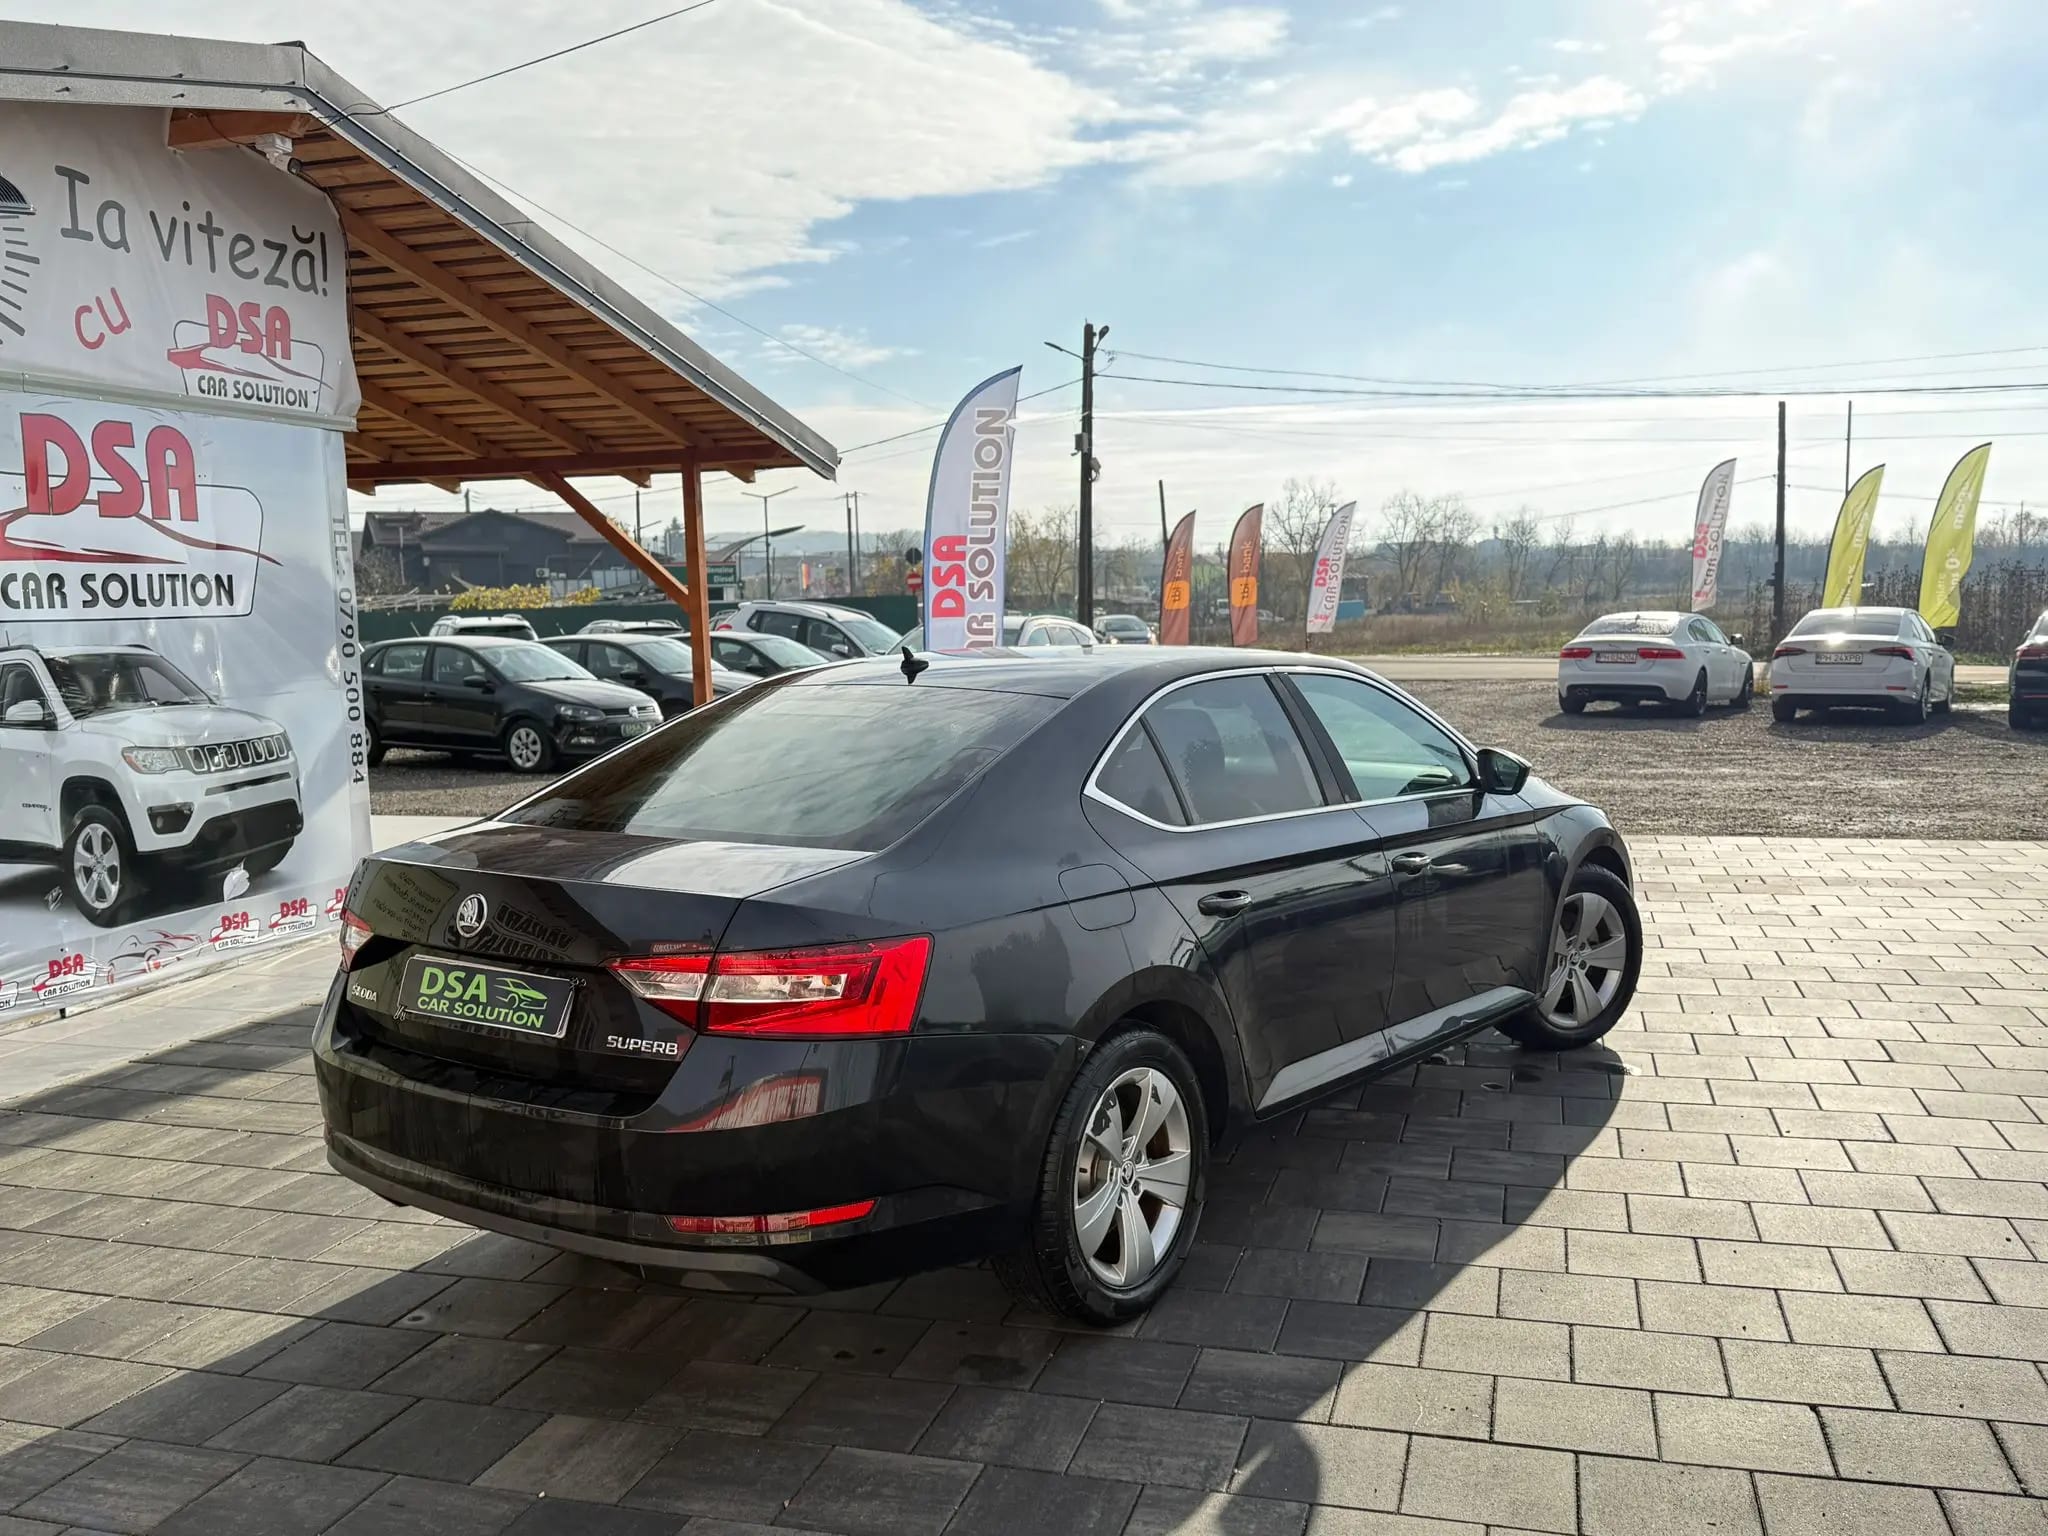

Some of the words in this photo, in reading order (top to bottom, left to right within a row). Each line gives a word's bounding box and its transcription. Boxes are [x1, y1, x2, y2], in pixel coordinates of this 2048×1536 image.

[54, 165, 131, 253] Ia
[149, 201, 328, 297] viteză!
[74, 287, 132, 350] cu
[206, 293, 291, 360] DSA
[198, 375, 228, 397] CAR
[233, 380, 308, 408] SOLUTION
[19, 412, 199, 522] DSA
[968, 408, 1007, 600] SOLUTION
[1708, 473, 1730, 553] SOLUTION
[1240, 541, 1252, 573] bank
[1328, 514, 1350, 582] SOLUTION
[1, 572, 68, 609] CAR
[80, 573, 235, 608] SOLUTION
[932, 535, 967, 618] DSA
[1315, 557, 1330, 588] DSA
[1323, 585, 1337, 611] CAR
[338, 587, 355, 658] 0790
[964, 614, 996, 649] AR
[343, 670, 361, 722] 500
[350, 732, 365, 784] 884
[221, 911, 249, 932] DSA
[280, 897, 308, 917] DSA
[288, 920, 313, 931] SOLUTION
[218, 941, 229, 949] CAR
[48, 953, 84, 979] DSA
[43, 987, 57, 998] CAR
[59, 979, 91, 995] SOLUTION
[420, 966, 487, 1003] DSA
[417, 996, 449, 1013] CAR
[453, 1002, 544, 1029] SOLUTION
[606, 1035, 678, 1055] SUPERB
